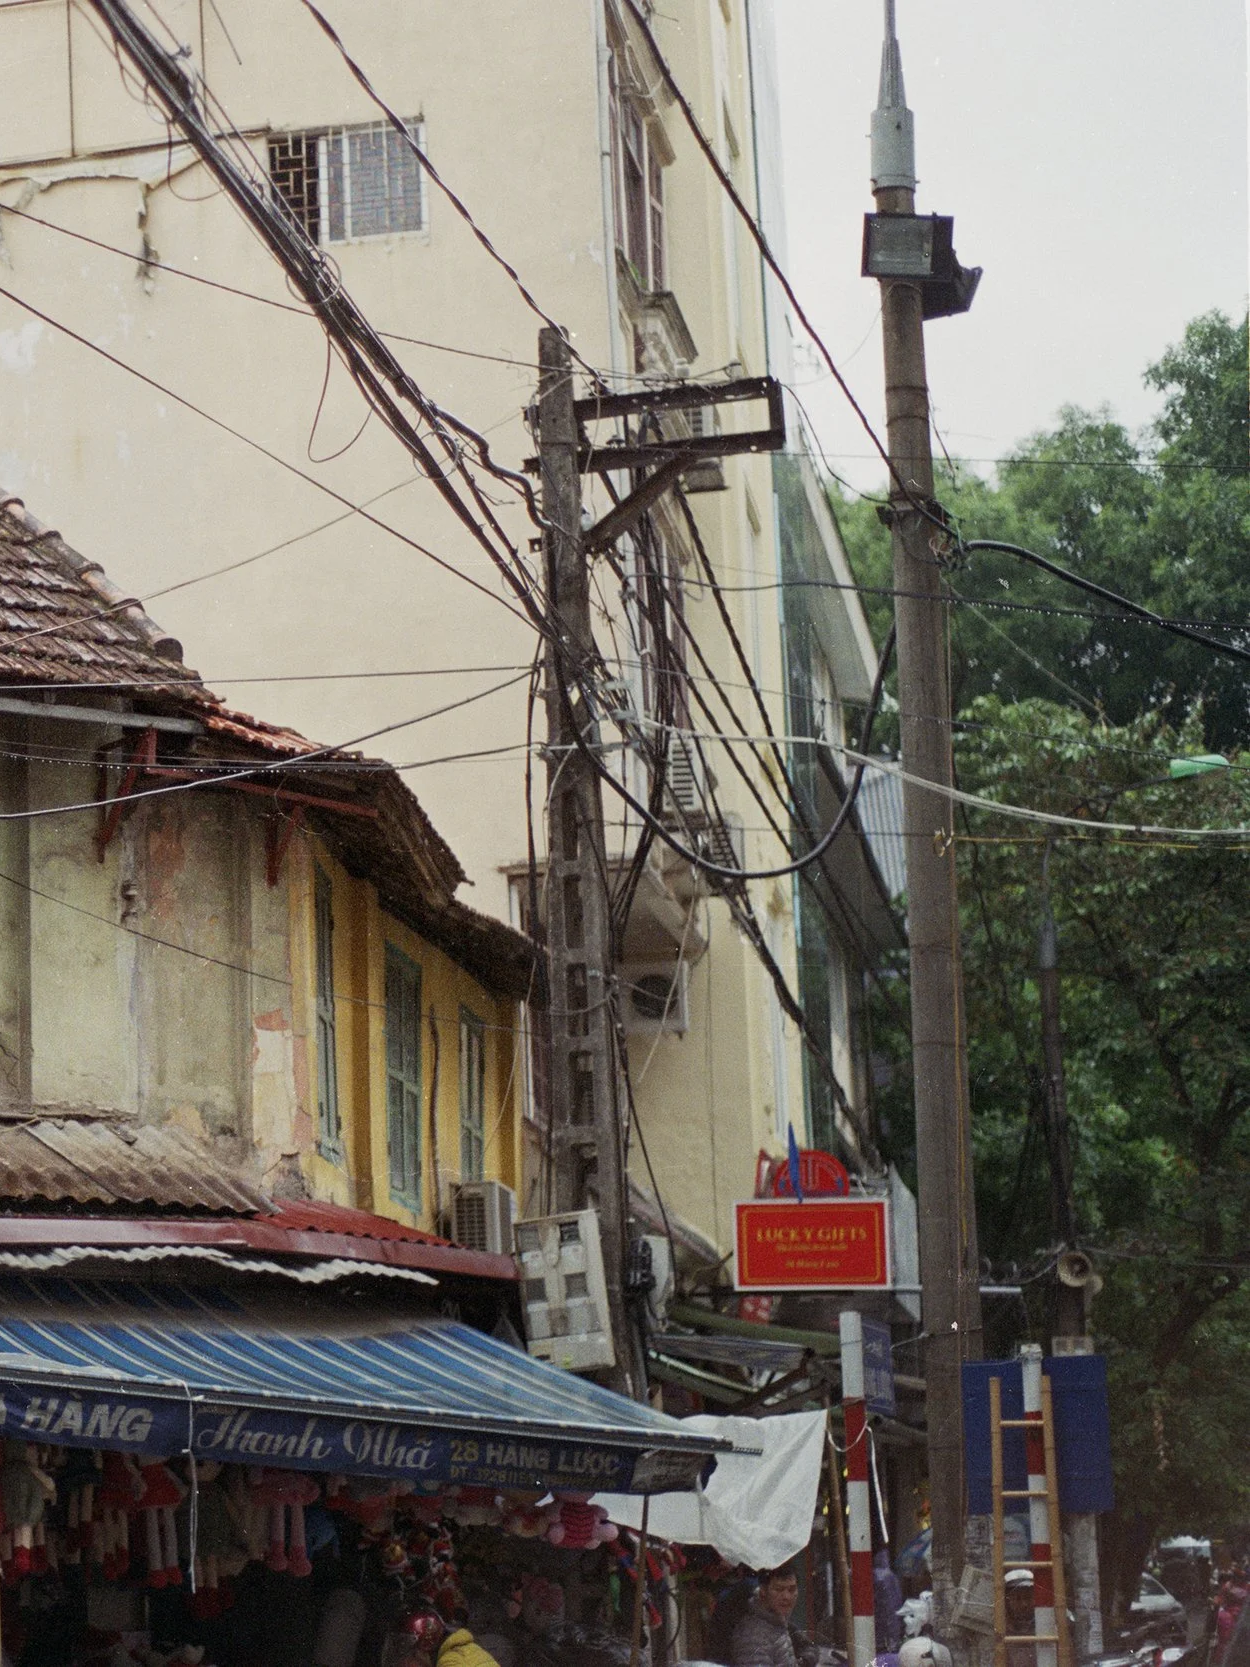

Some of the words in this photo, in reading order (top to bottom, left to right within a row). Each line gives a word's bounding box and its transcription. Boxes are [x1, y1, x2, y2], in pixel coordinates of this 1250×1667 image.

[756, 1227, 813, 1242] LUCKY
[817, 1226, 867, 1241] GIFTS
[21, 1390, 154, 1442] HÀNG
[195, 1406, 332, 1460] Thanh
[343, 1421, 436, 1471] Nhã
[449, 1439, 479, 1462] 28
[486, 1439, 551, 1470] HÀNG
